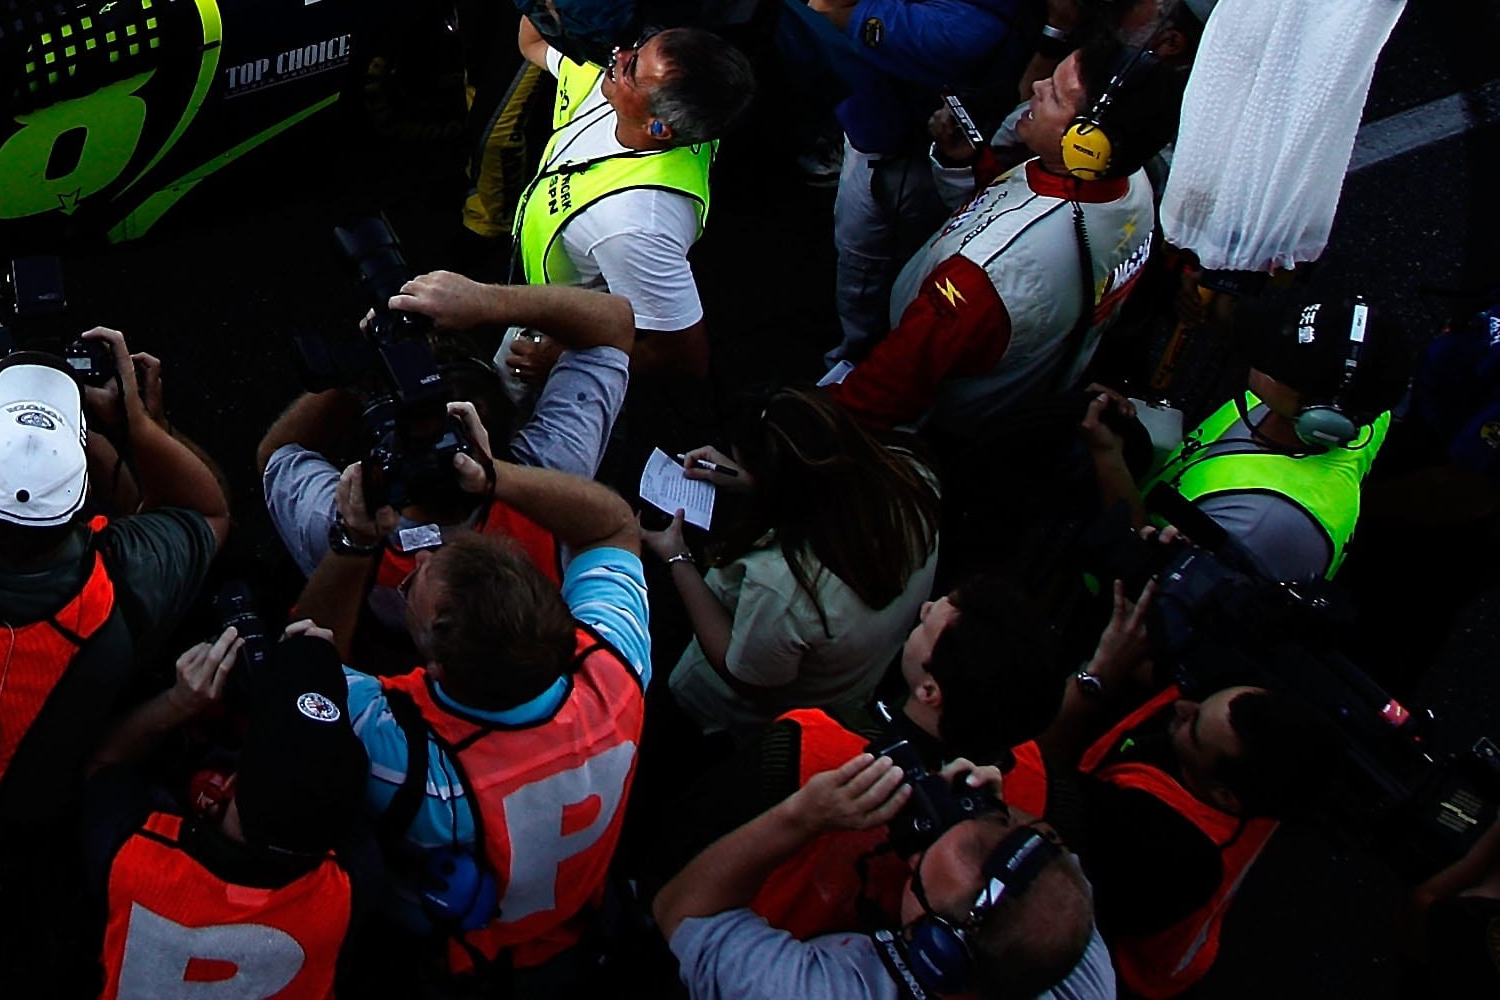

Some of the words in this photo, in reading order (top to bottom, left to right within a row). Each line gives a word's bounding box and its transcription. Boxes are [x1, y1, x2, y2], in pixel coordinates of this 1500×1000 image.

[225, 58, 270, 89] TOP
[276, 33, 351, 75] CHOICE
[946, 94, 985, 143] ESPN
[498, 738, 637, 925] P
